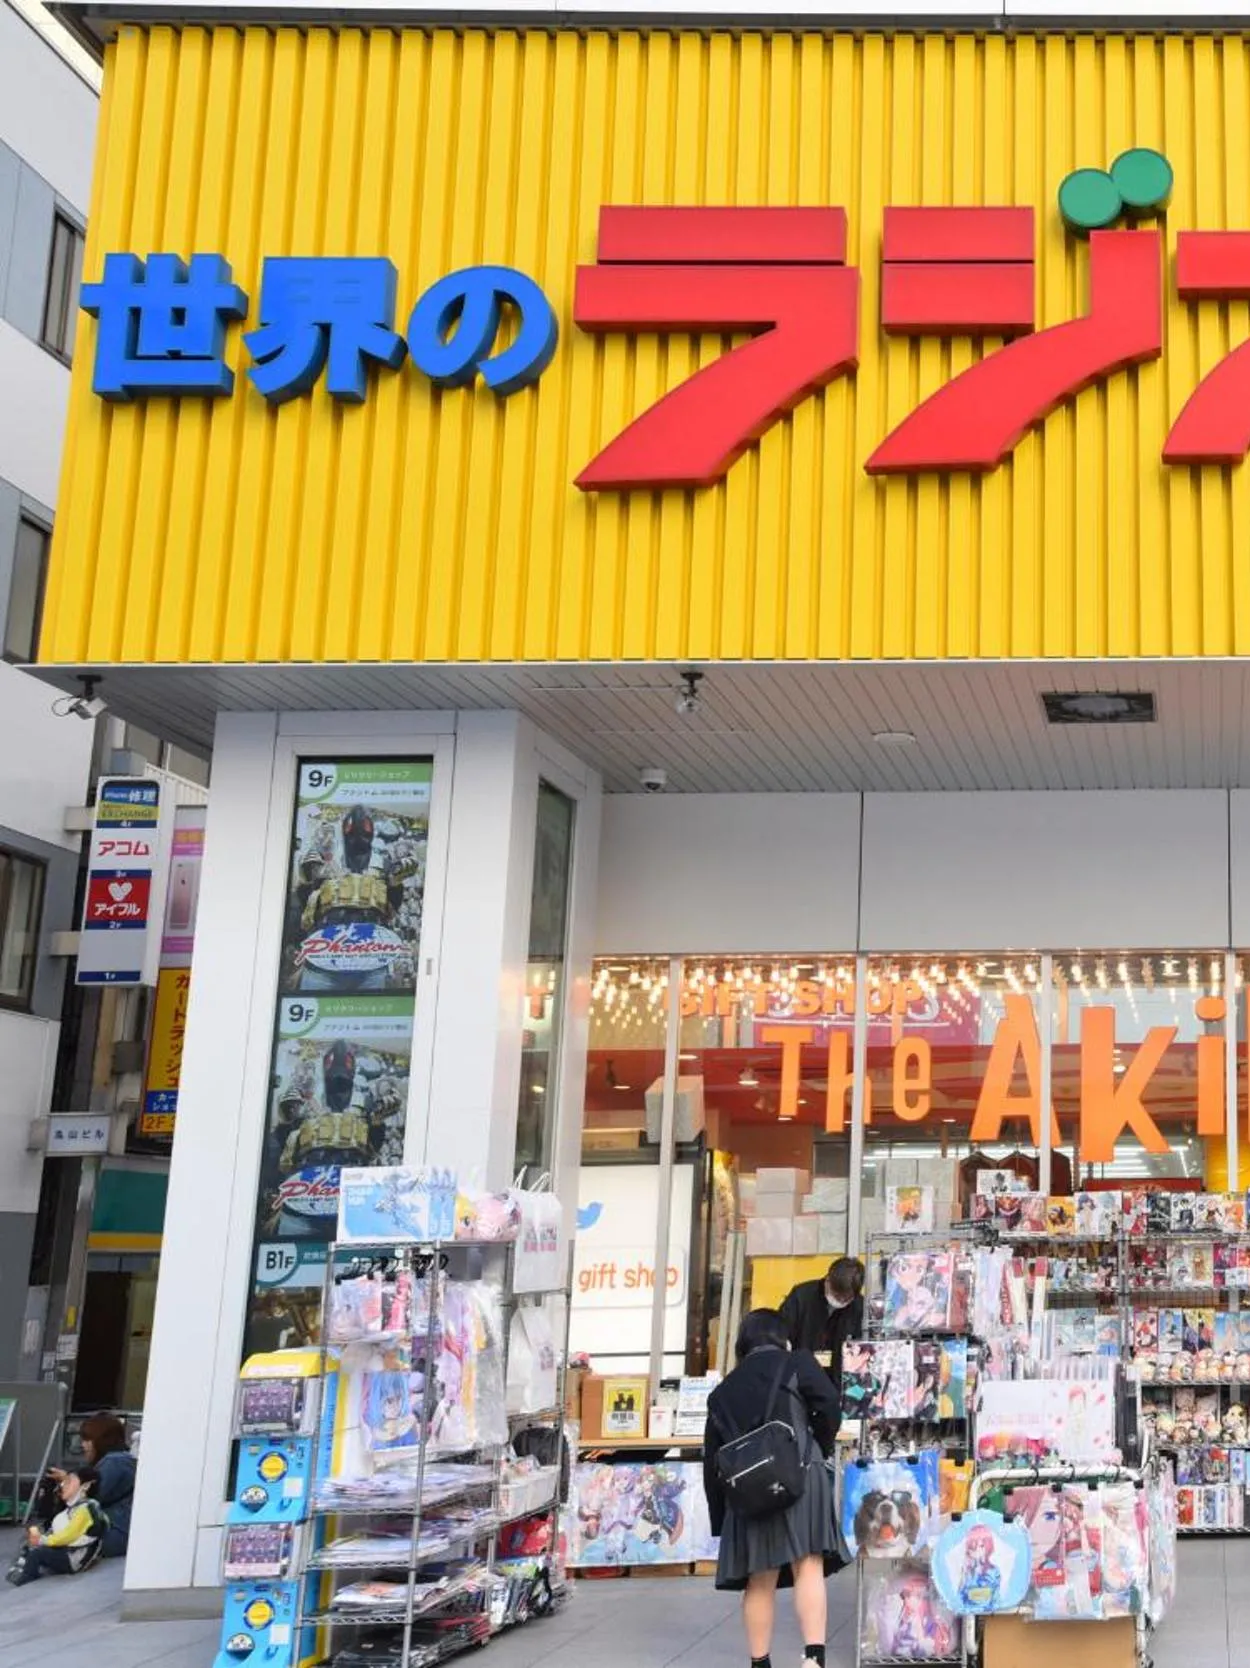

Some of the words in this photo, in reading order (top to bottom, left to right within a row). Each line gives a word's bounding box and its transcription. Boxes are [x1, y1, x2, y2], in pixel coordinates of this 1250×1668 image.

[79, 252, 560, 401] 世界の
[309, 770, 333, 787] 9F
[98, 841, 149, 856] アコム
[94, 903, 140, 916] アイフル
[289, 1004, 314, 1022] 9F
[761, 1025, 932, 1133] The
[267, 1251, 295, 1269] B1F
[578, 1263, 617, 1292] gift
